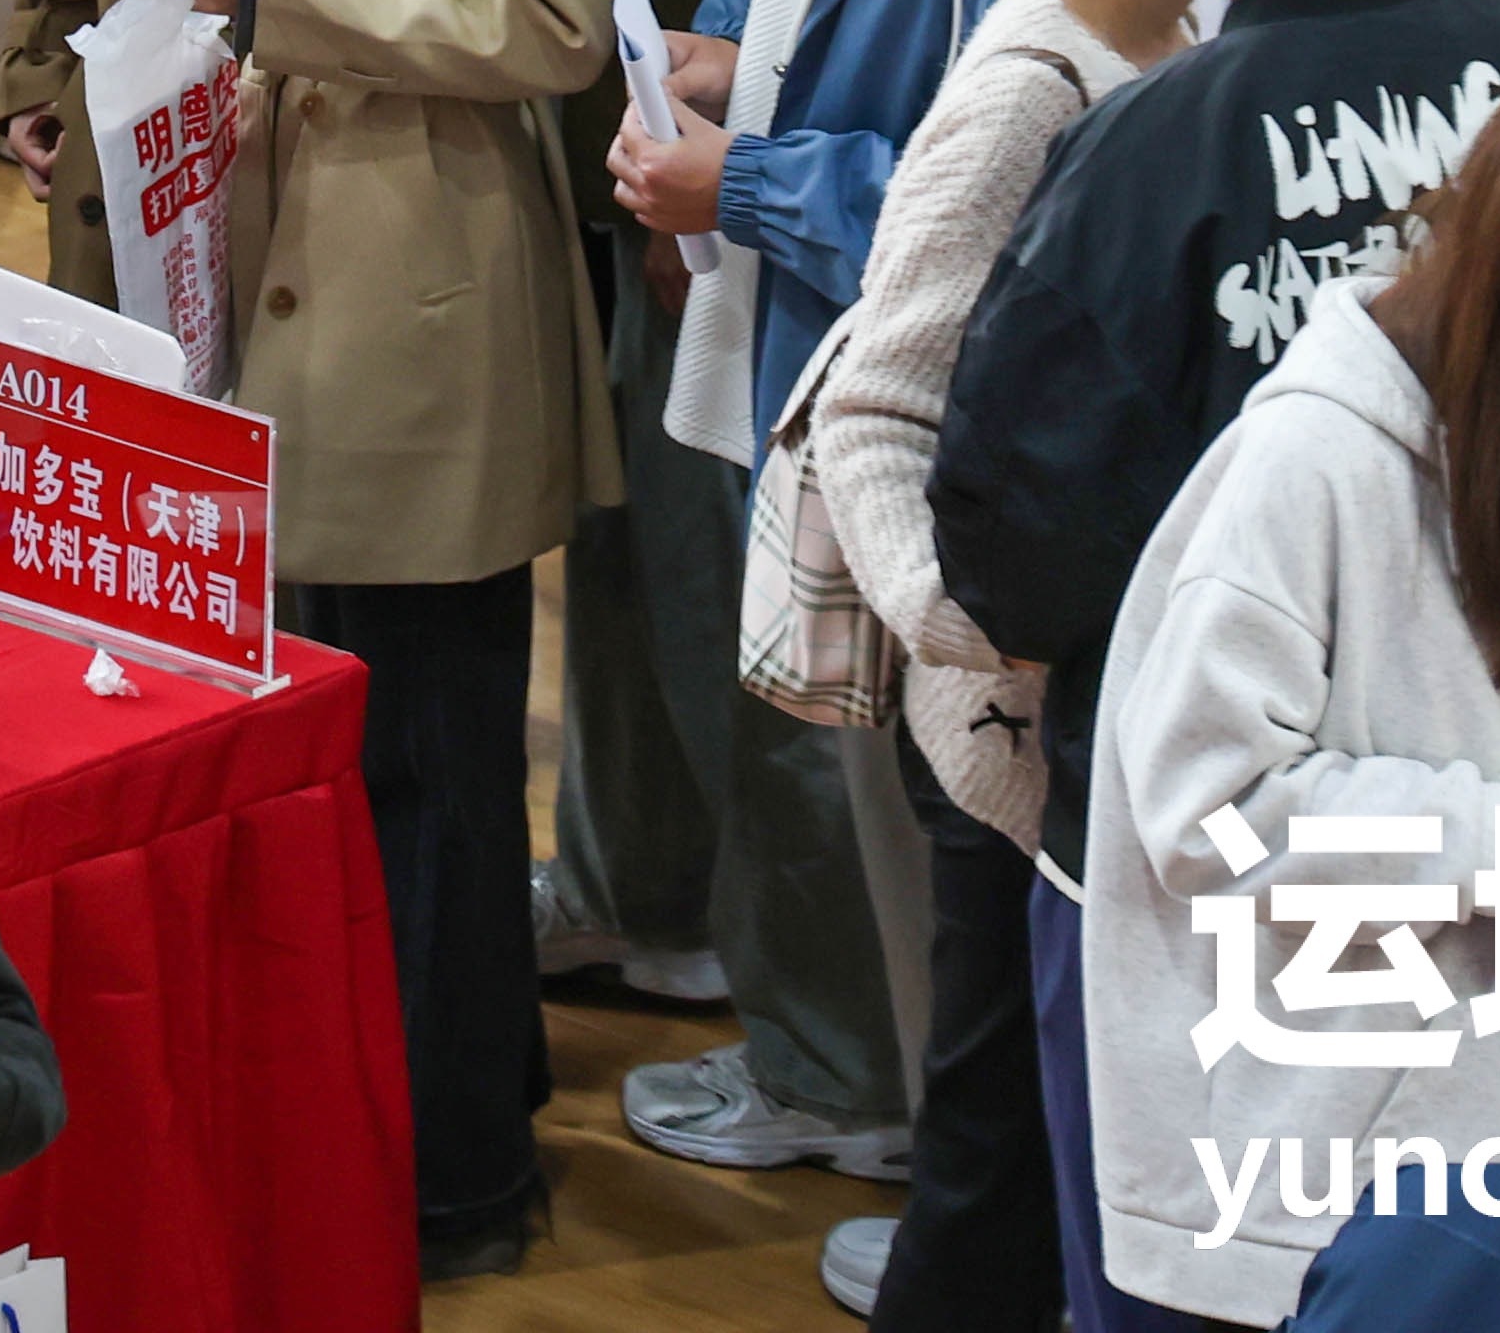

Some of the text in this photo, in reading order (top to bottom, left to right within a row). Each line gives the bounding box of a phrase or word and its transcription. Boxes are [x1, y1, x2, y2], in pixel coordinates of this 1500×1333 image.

[10, 506, 238, 635] 饮料有限公司
